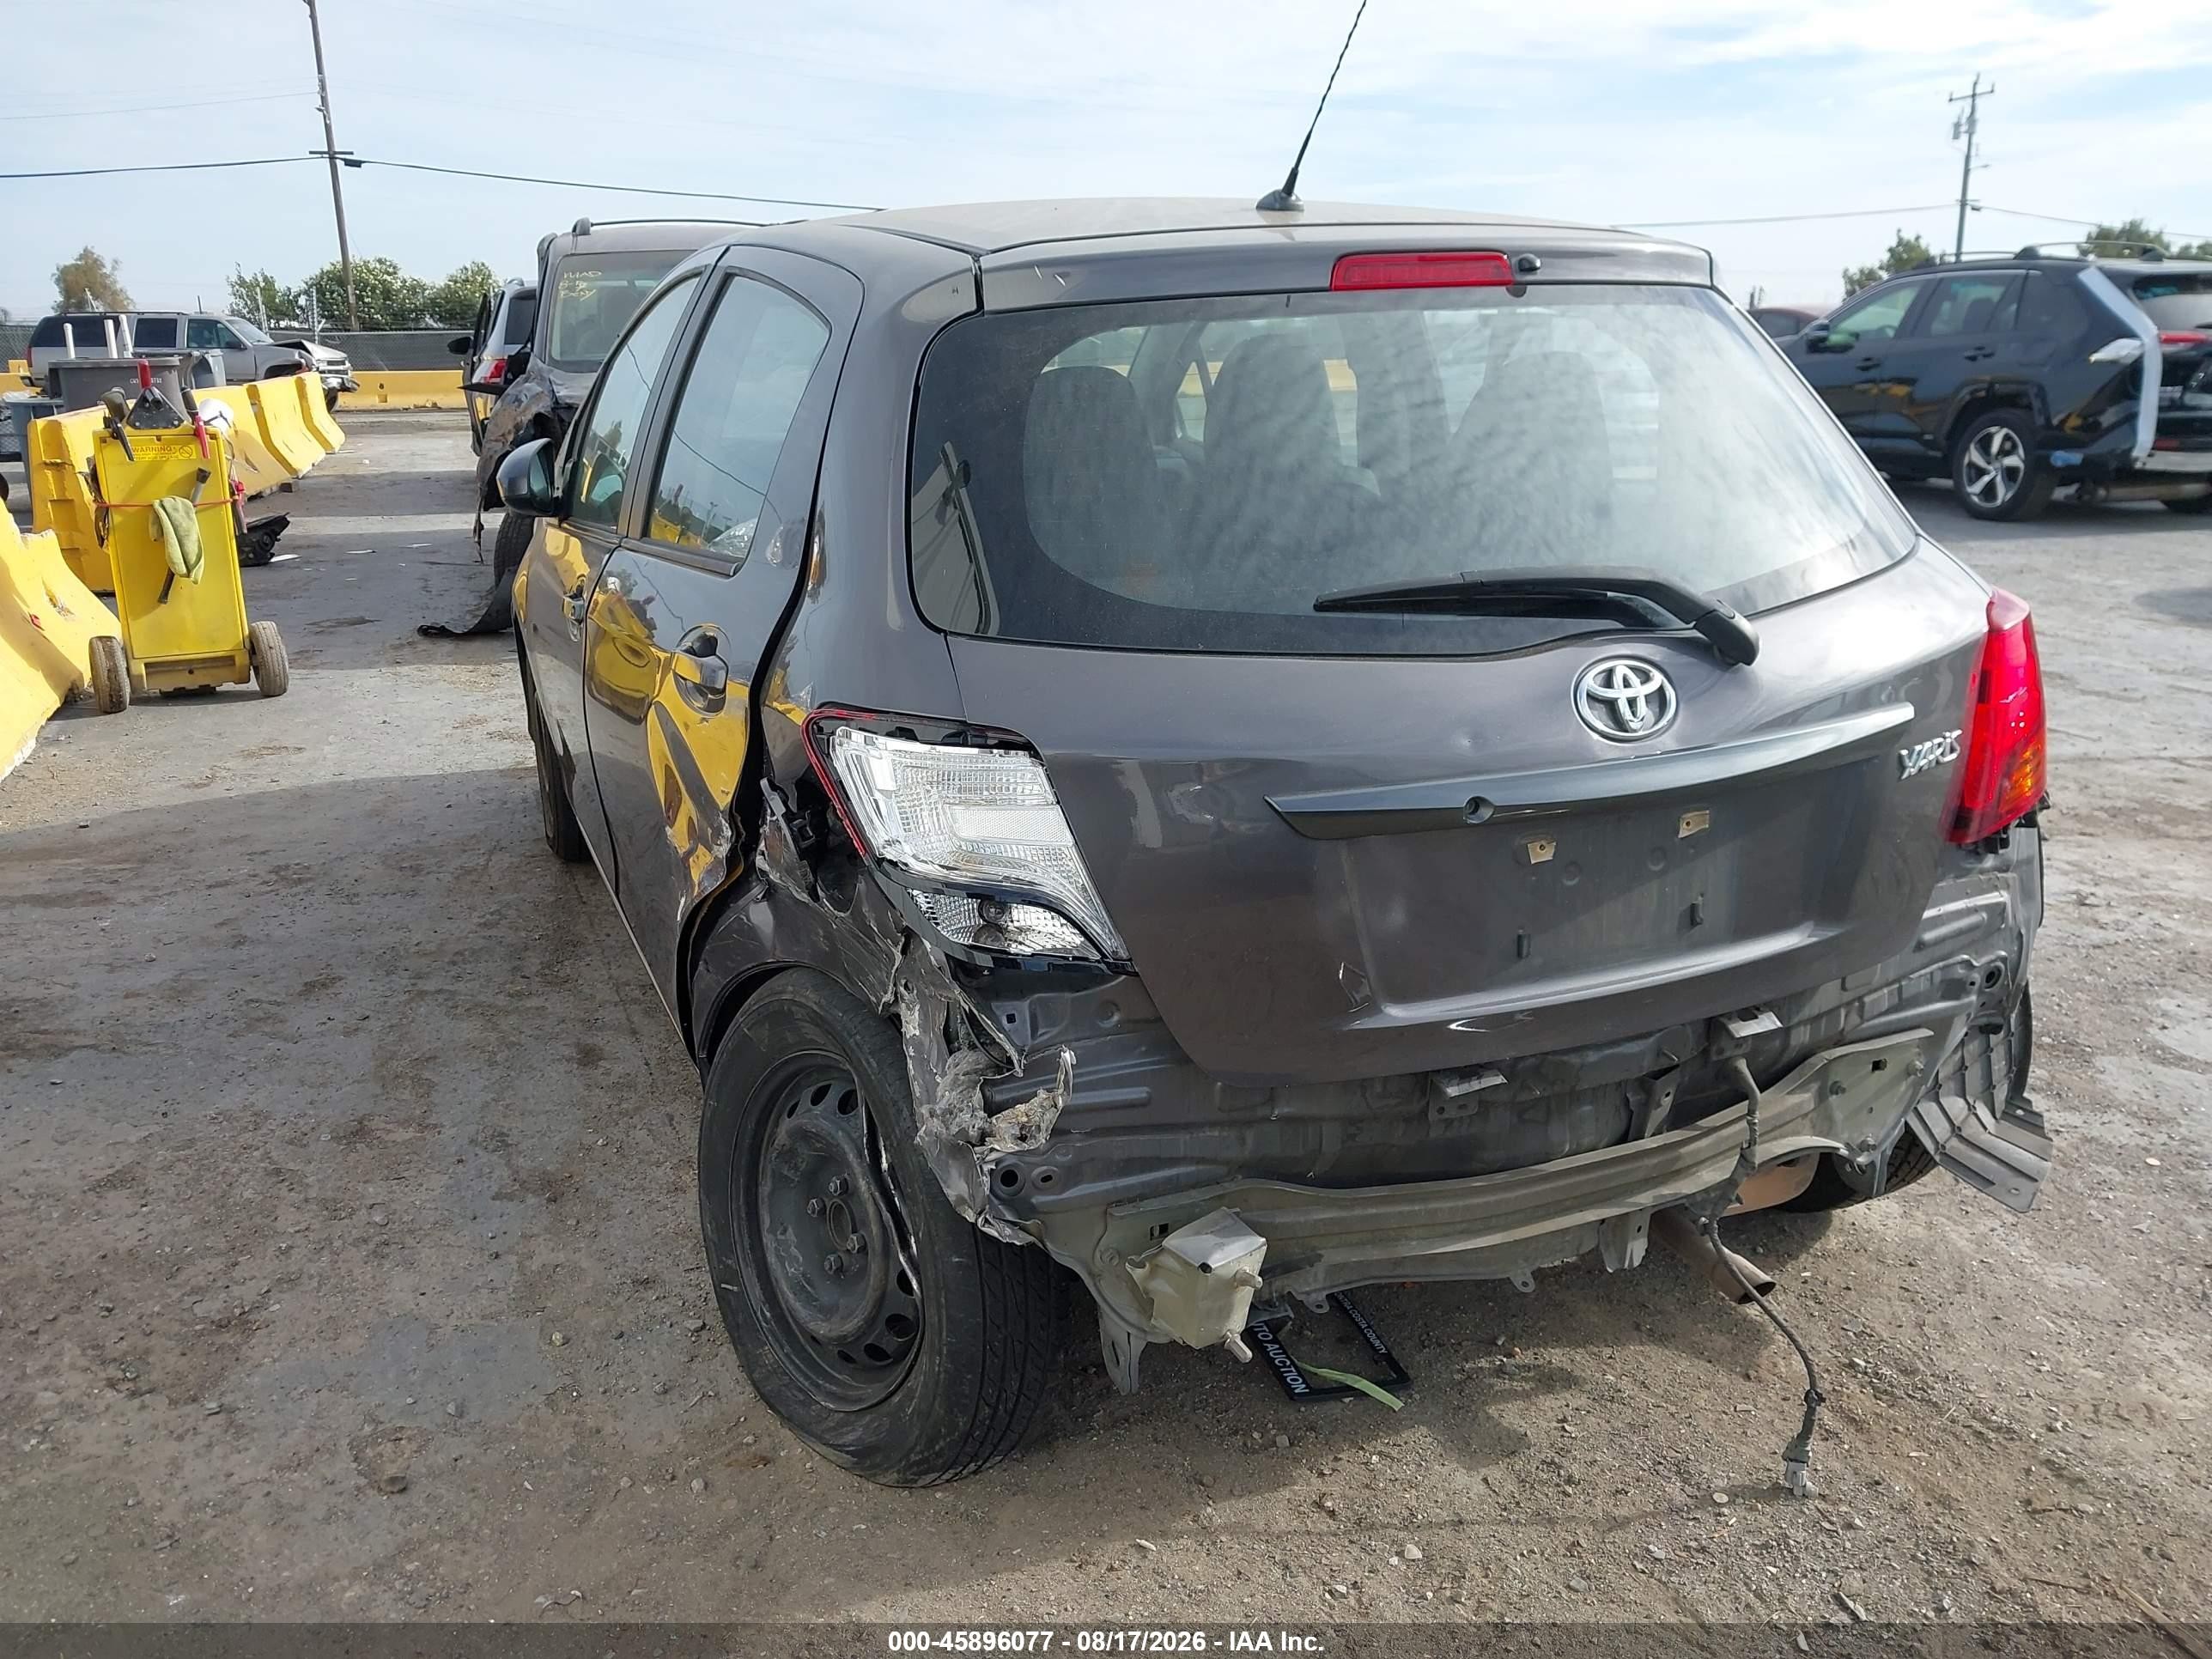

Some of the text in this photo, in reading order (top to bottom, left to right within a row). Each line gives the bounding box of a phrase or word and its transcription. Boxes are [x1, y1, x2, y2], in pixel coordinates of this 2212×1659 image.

[1253, 1322, 1310, 1394] TO AUCTION
[1348, 1309, 1368, 1329] COSTA
[1364, 1328, 1389, 1354] COUNTY
